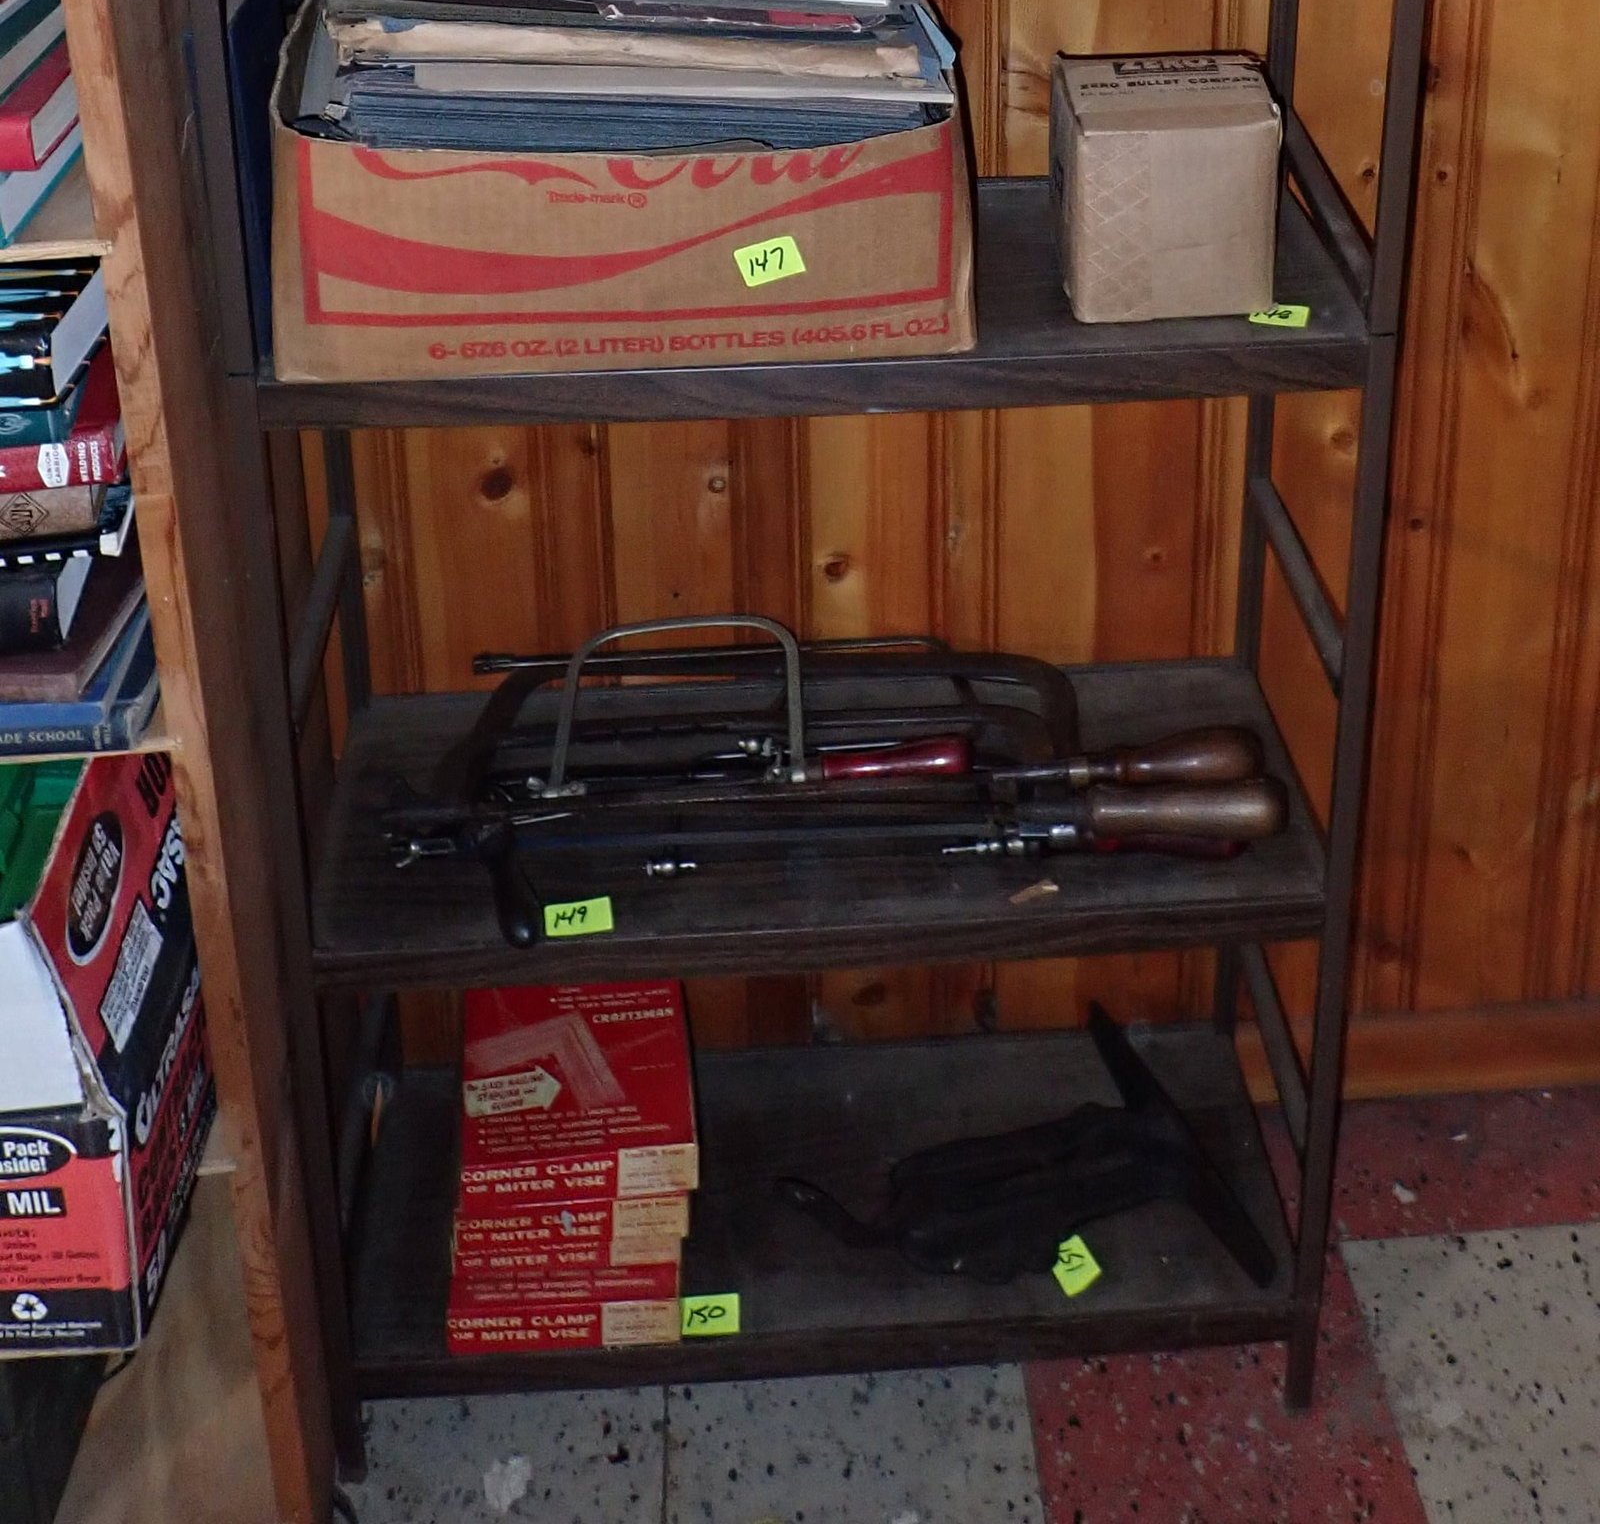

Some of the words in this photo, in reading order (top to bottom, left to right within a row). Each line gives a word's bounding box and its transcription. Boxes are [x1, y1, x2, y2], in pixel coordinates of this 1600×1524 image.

[1126, 79, 1179, 88] BULLET
[1188, 76, 1260, 84] COMPANY
[748, 246, 785, 277] 147
[583, 334, 665, 355] LITER)
[668, 330, 786, 352] BOTTLES
[28, 729, 85, 742] SCHOOL
[553, 905, 588, 929] 149
[592, 1007, 674, 1024] CRAFTSMAN
[3, 1139, 50, 1158] Pack
[461, 1165, 537, 1182] CORNER
[545, 1160, 614, 1175] CLAMP
[494, 1178, 555, 1194] MITER
[564, 1175, 606, 1188] VISE
[7, 1190, 62, 1216] MIL
[490, 1228, 551, 1242] MITER
[490, 1254, 549, 1268] MITER
[558, 1251, 598, 1263] VISE
[447, 1316, 523, 1330] CORNER
[531, 1313, 597, 1326] CLAMP
[686, 1305, 727, 1328] 150
[480, 1329, 540, 1342] MITER
[549, 1327, 589, 1339] VISE
